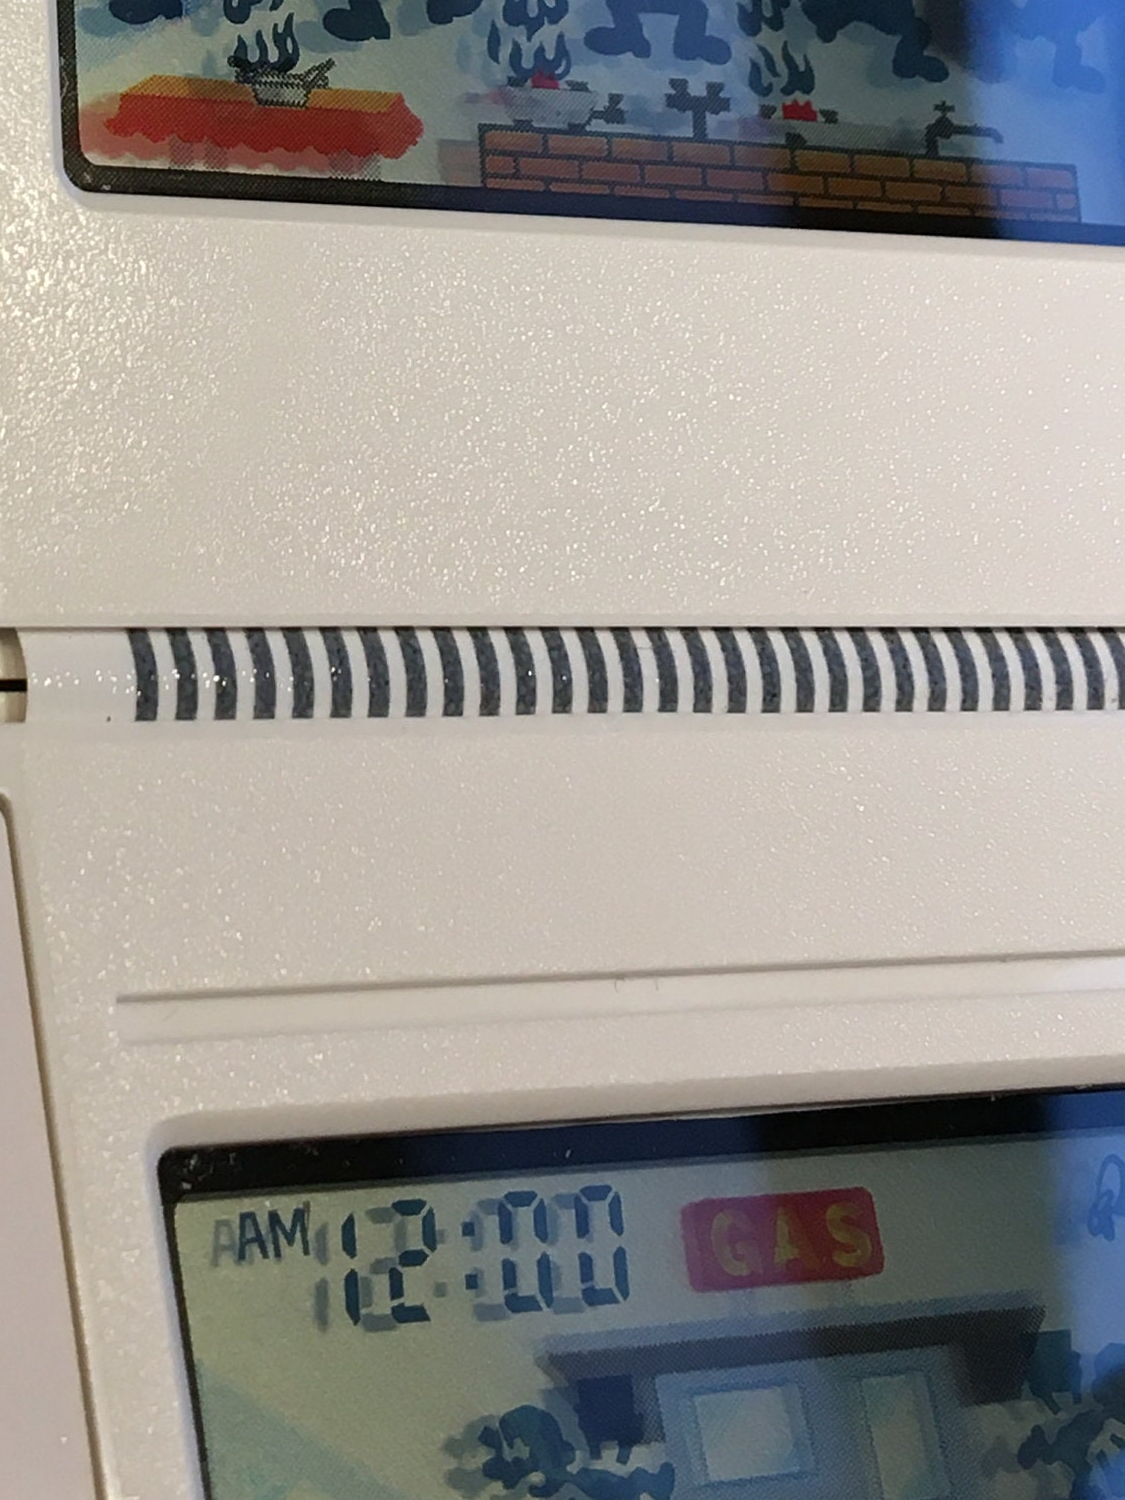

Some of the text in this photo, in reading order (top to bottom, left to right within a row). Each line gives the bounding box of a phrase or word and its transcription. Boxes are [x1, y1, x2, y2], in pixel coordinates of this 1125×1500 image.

[237, 1184, 631, 1326] AM 12:00
[712, 1200, 875, 1279] GAS
